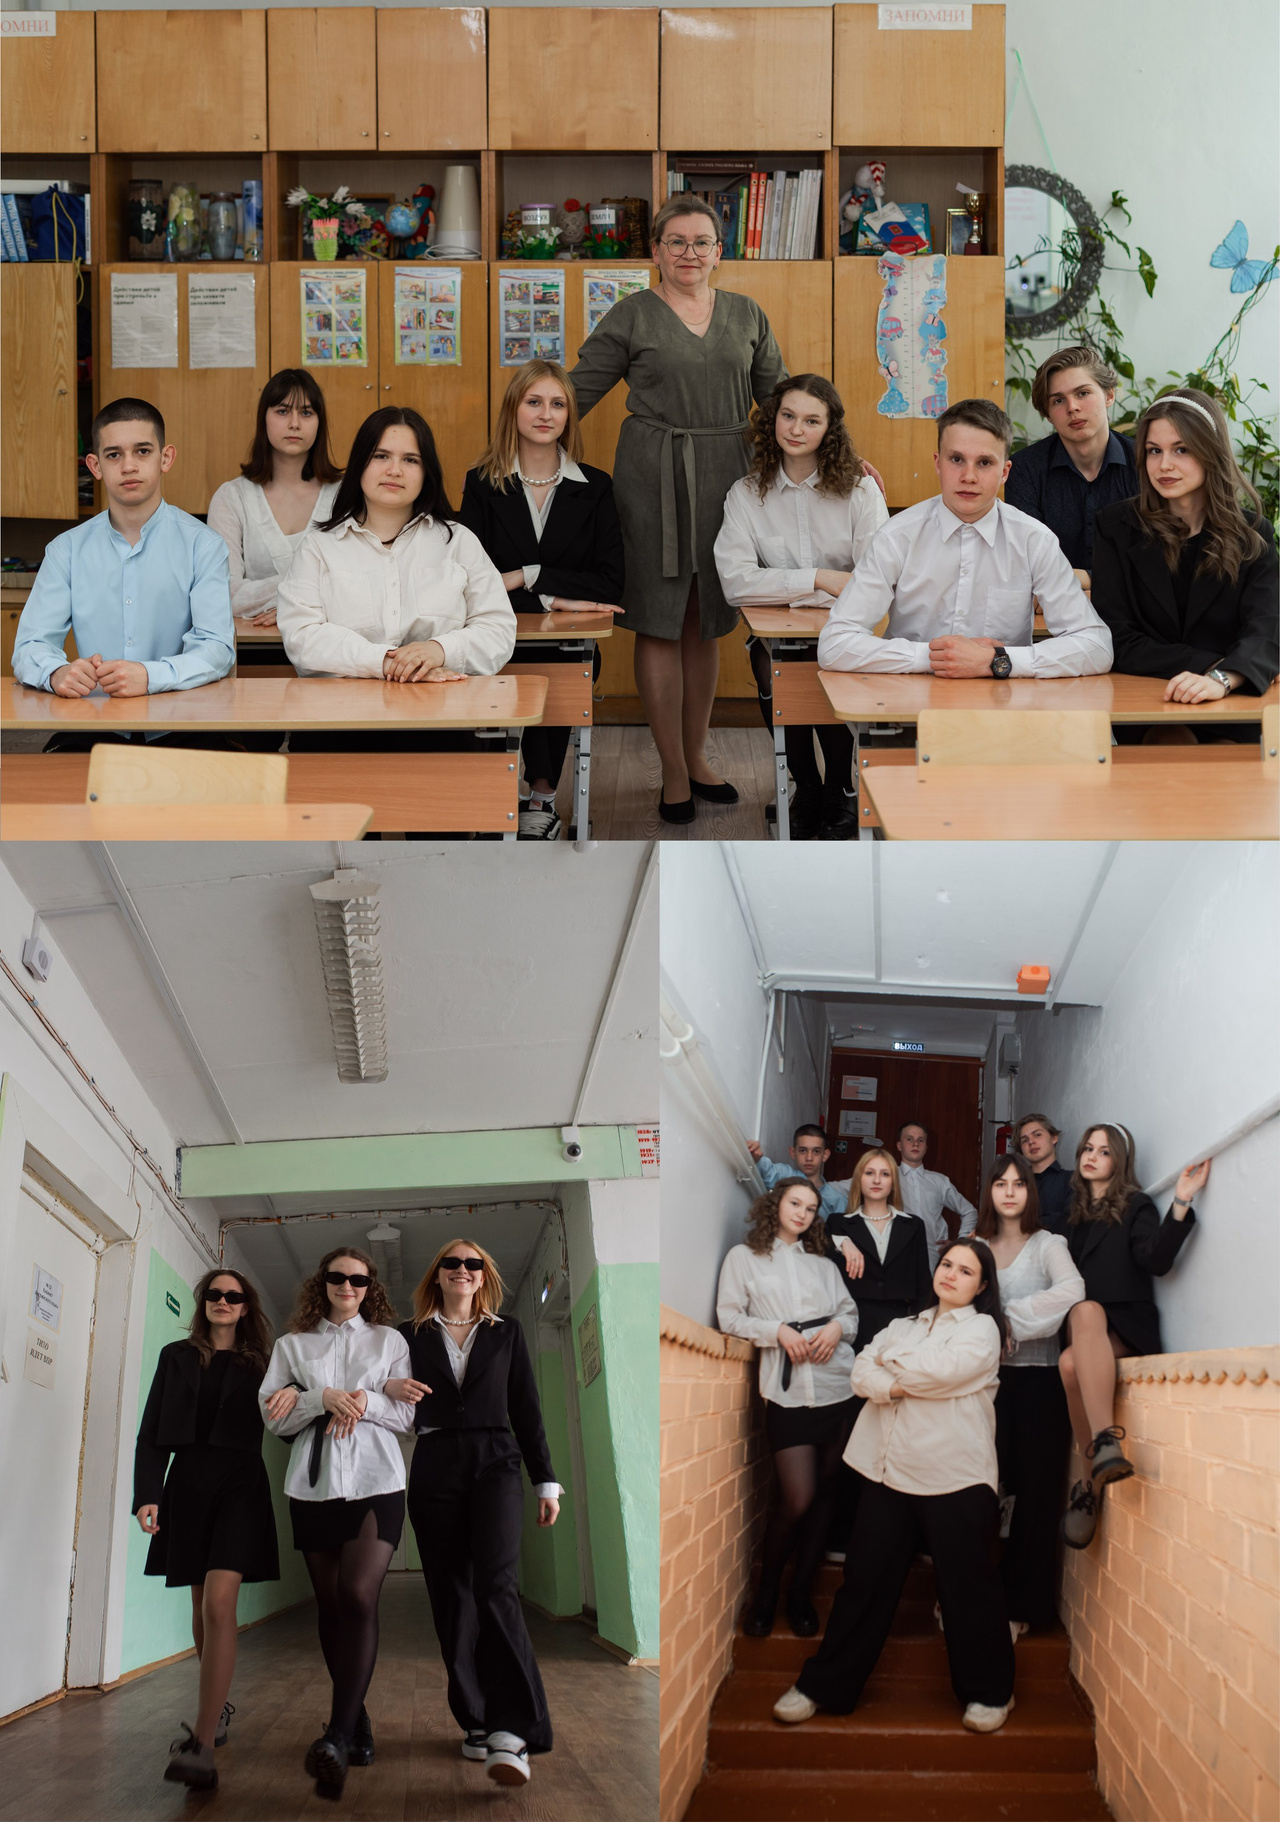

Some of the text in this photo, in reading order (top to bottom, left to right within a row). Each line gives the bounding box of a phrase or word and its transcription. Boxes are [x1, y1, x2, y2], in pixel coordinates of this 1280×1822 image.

[886, 9, 965, 22] ЗАПОМНИ
[1, 20, 49, 32] ОМНИ
[894, 1042, 923, 1051] ВЫХОД
